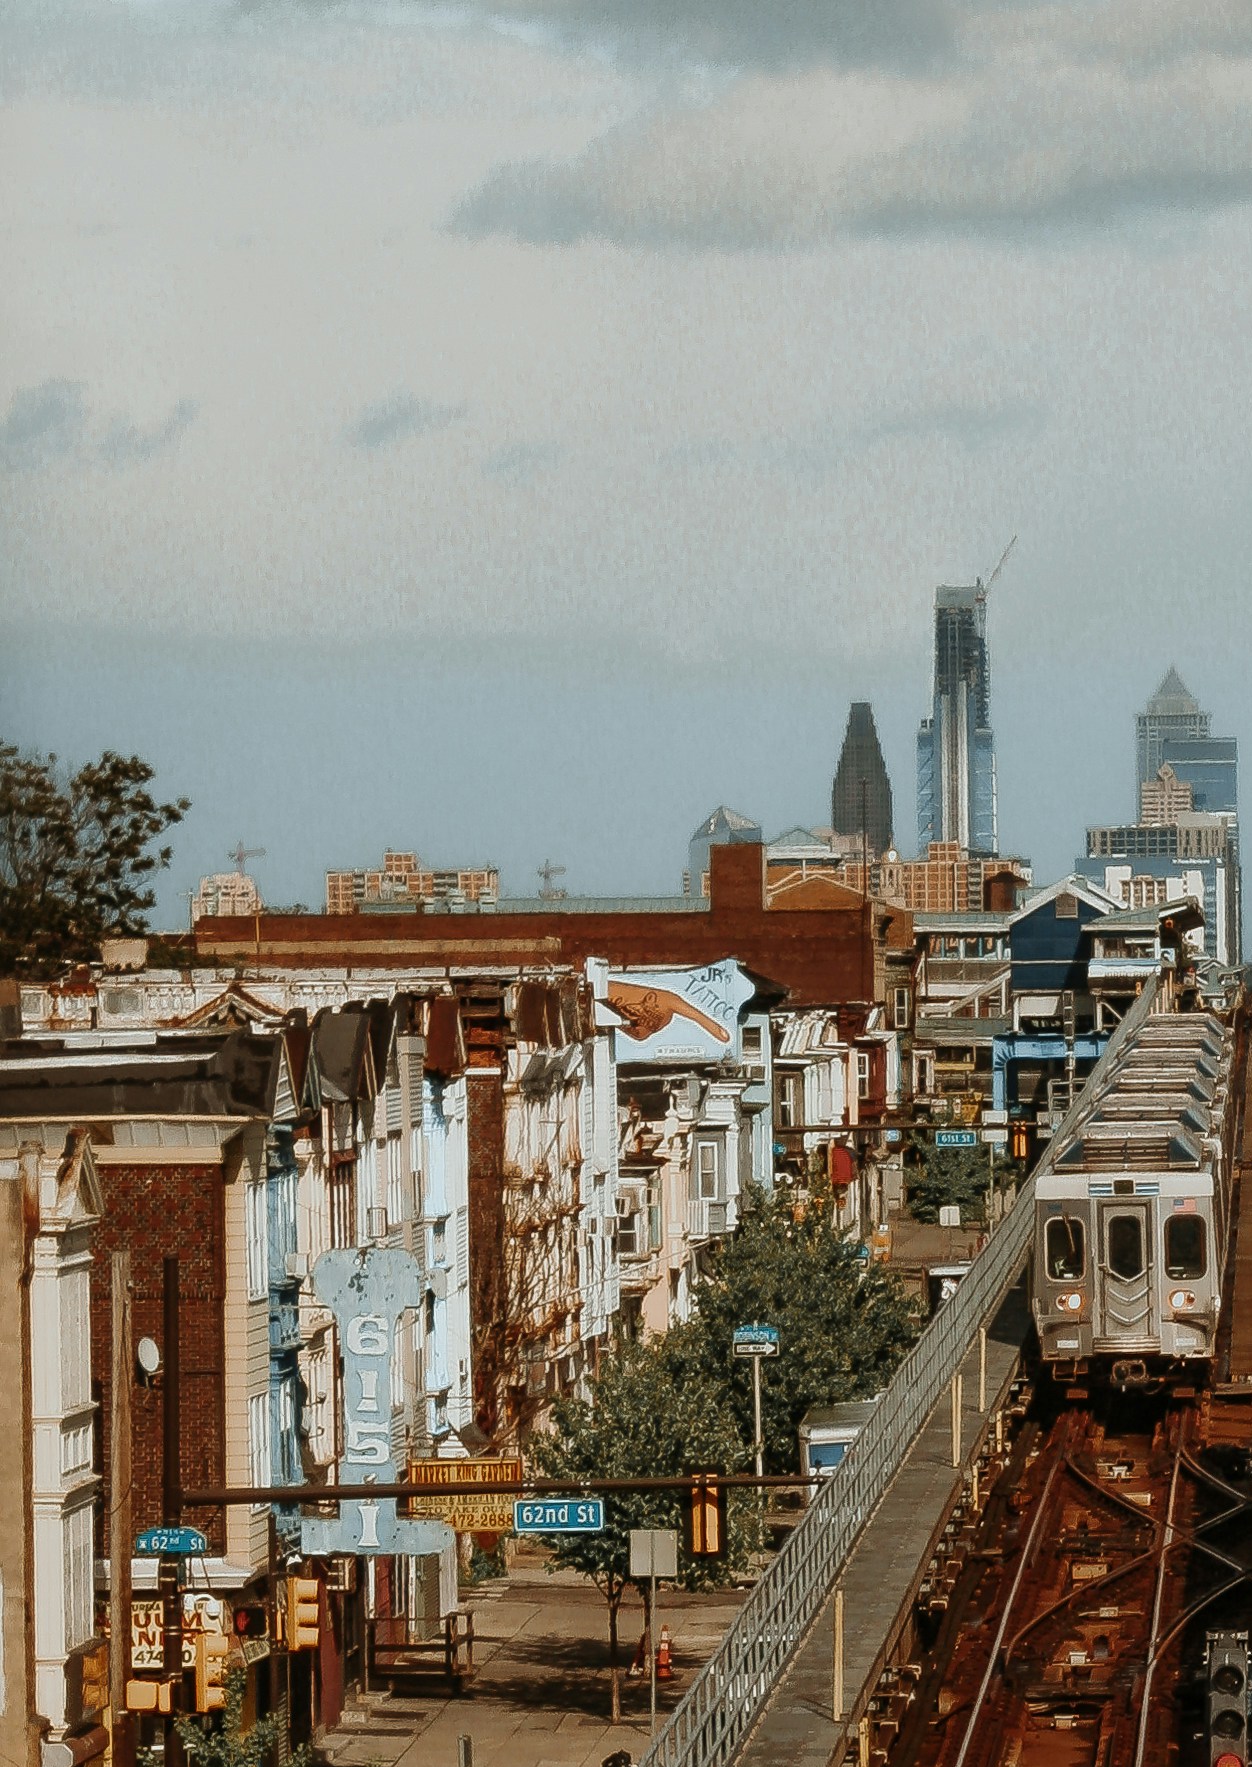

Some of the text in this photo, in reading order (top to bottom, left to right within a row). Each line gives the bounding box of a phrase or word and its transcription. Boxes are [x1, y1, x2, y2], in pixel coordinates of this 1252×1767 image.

[522, 1505, 595, 1523] 62nd St
[151, 1536, 203, 1550] 62nd St
